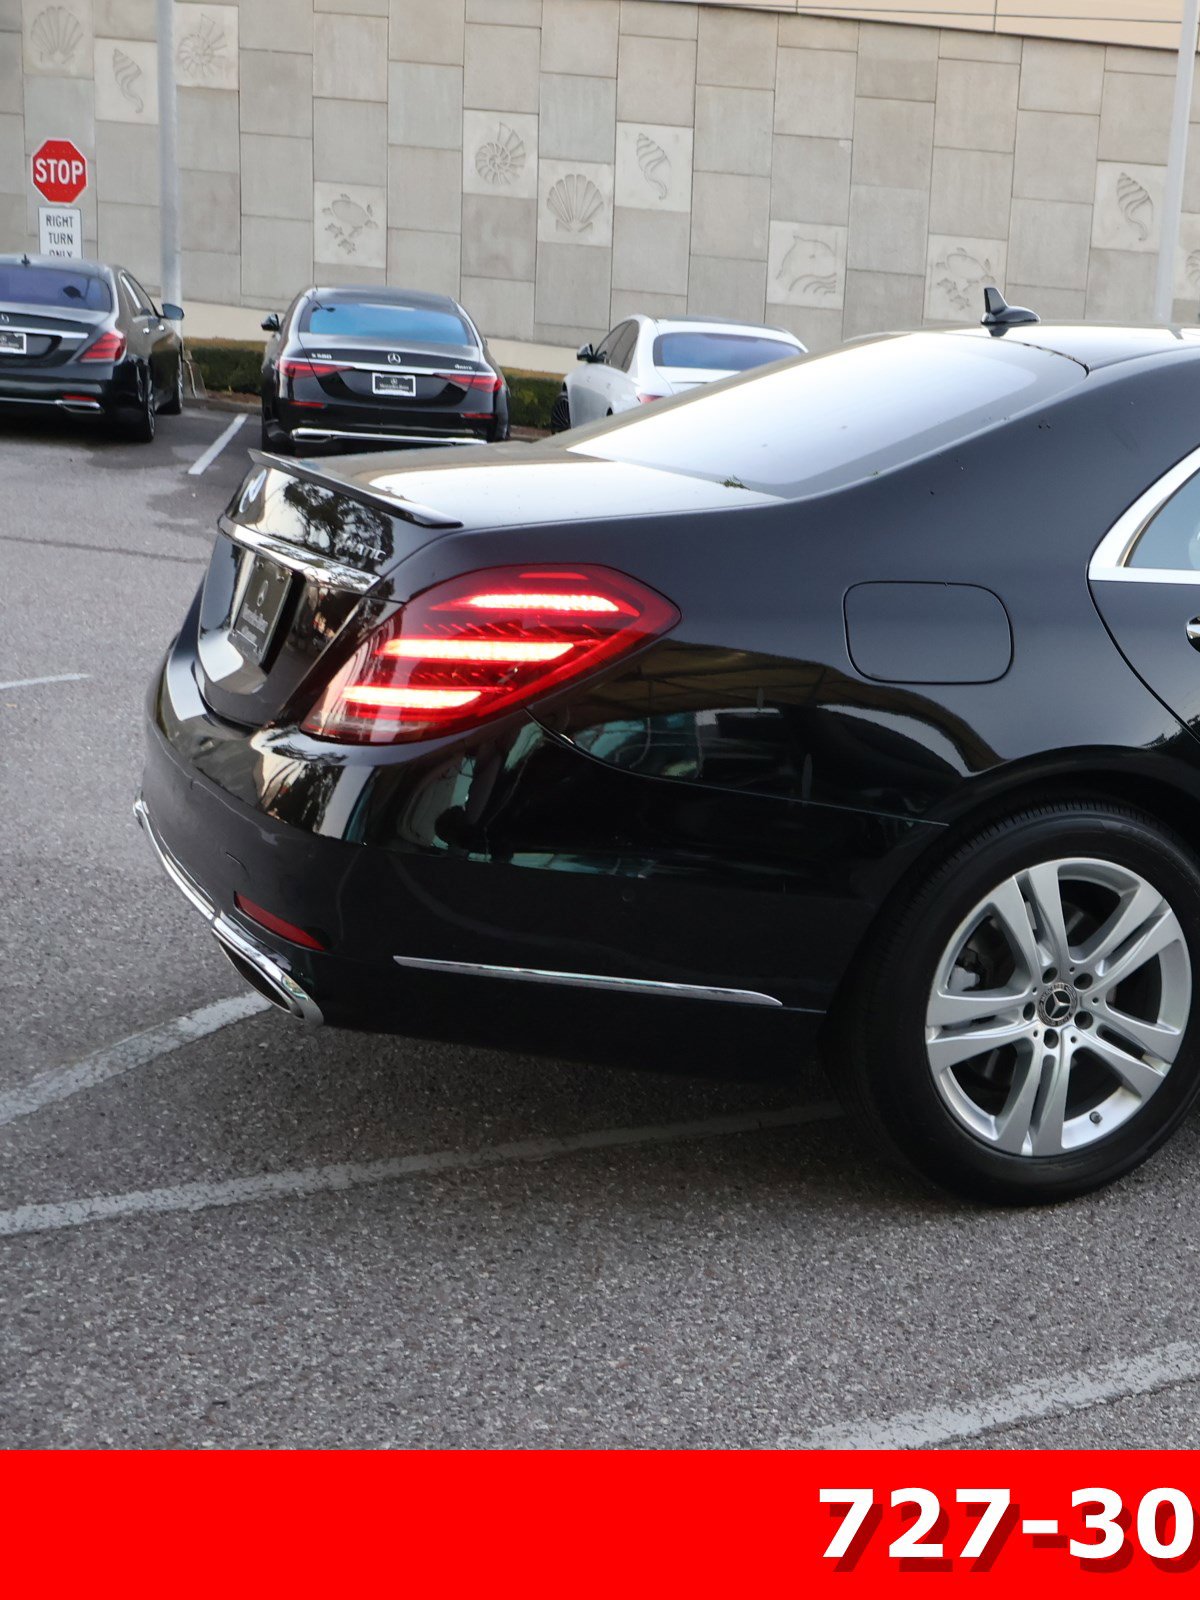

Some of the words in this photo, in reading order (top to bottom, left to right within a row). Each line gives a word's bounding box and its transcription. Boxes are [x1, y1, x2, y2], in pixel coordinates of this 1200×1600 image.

[35, 158, 84, 185] STOP
[46, 214, 74, 228] RIGHT
[48, 232, 74, 245] TURN
